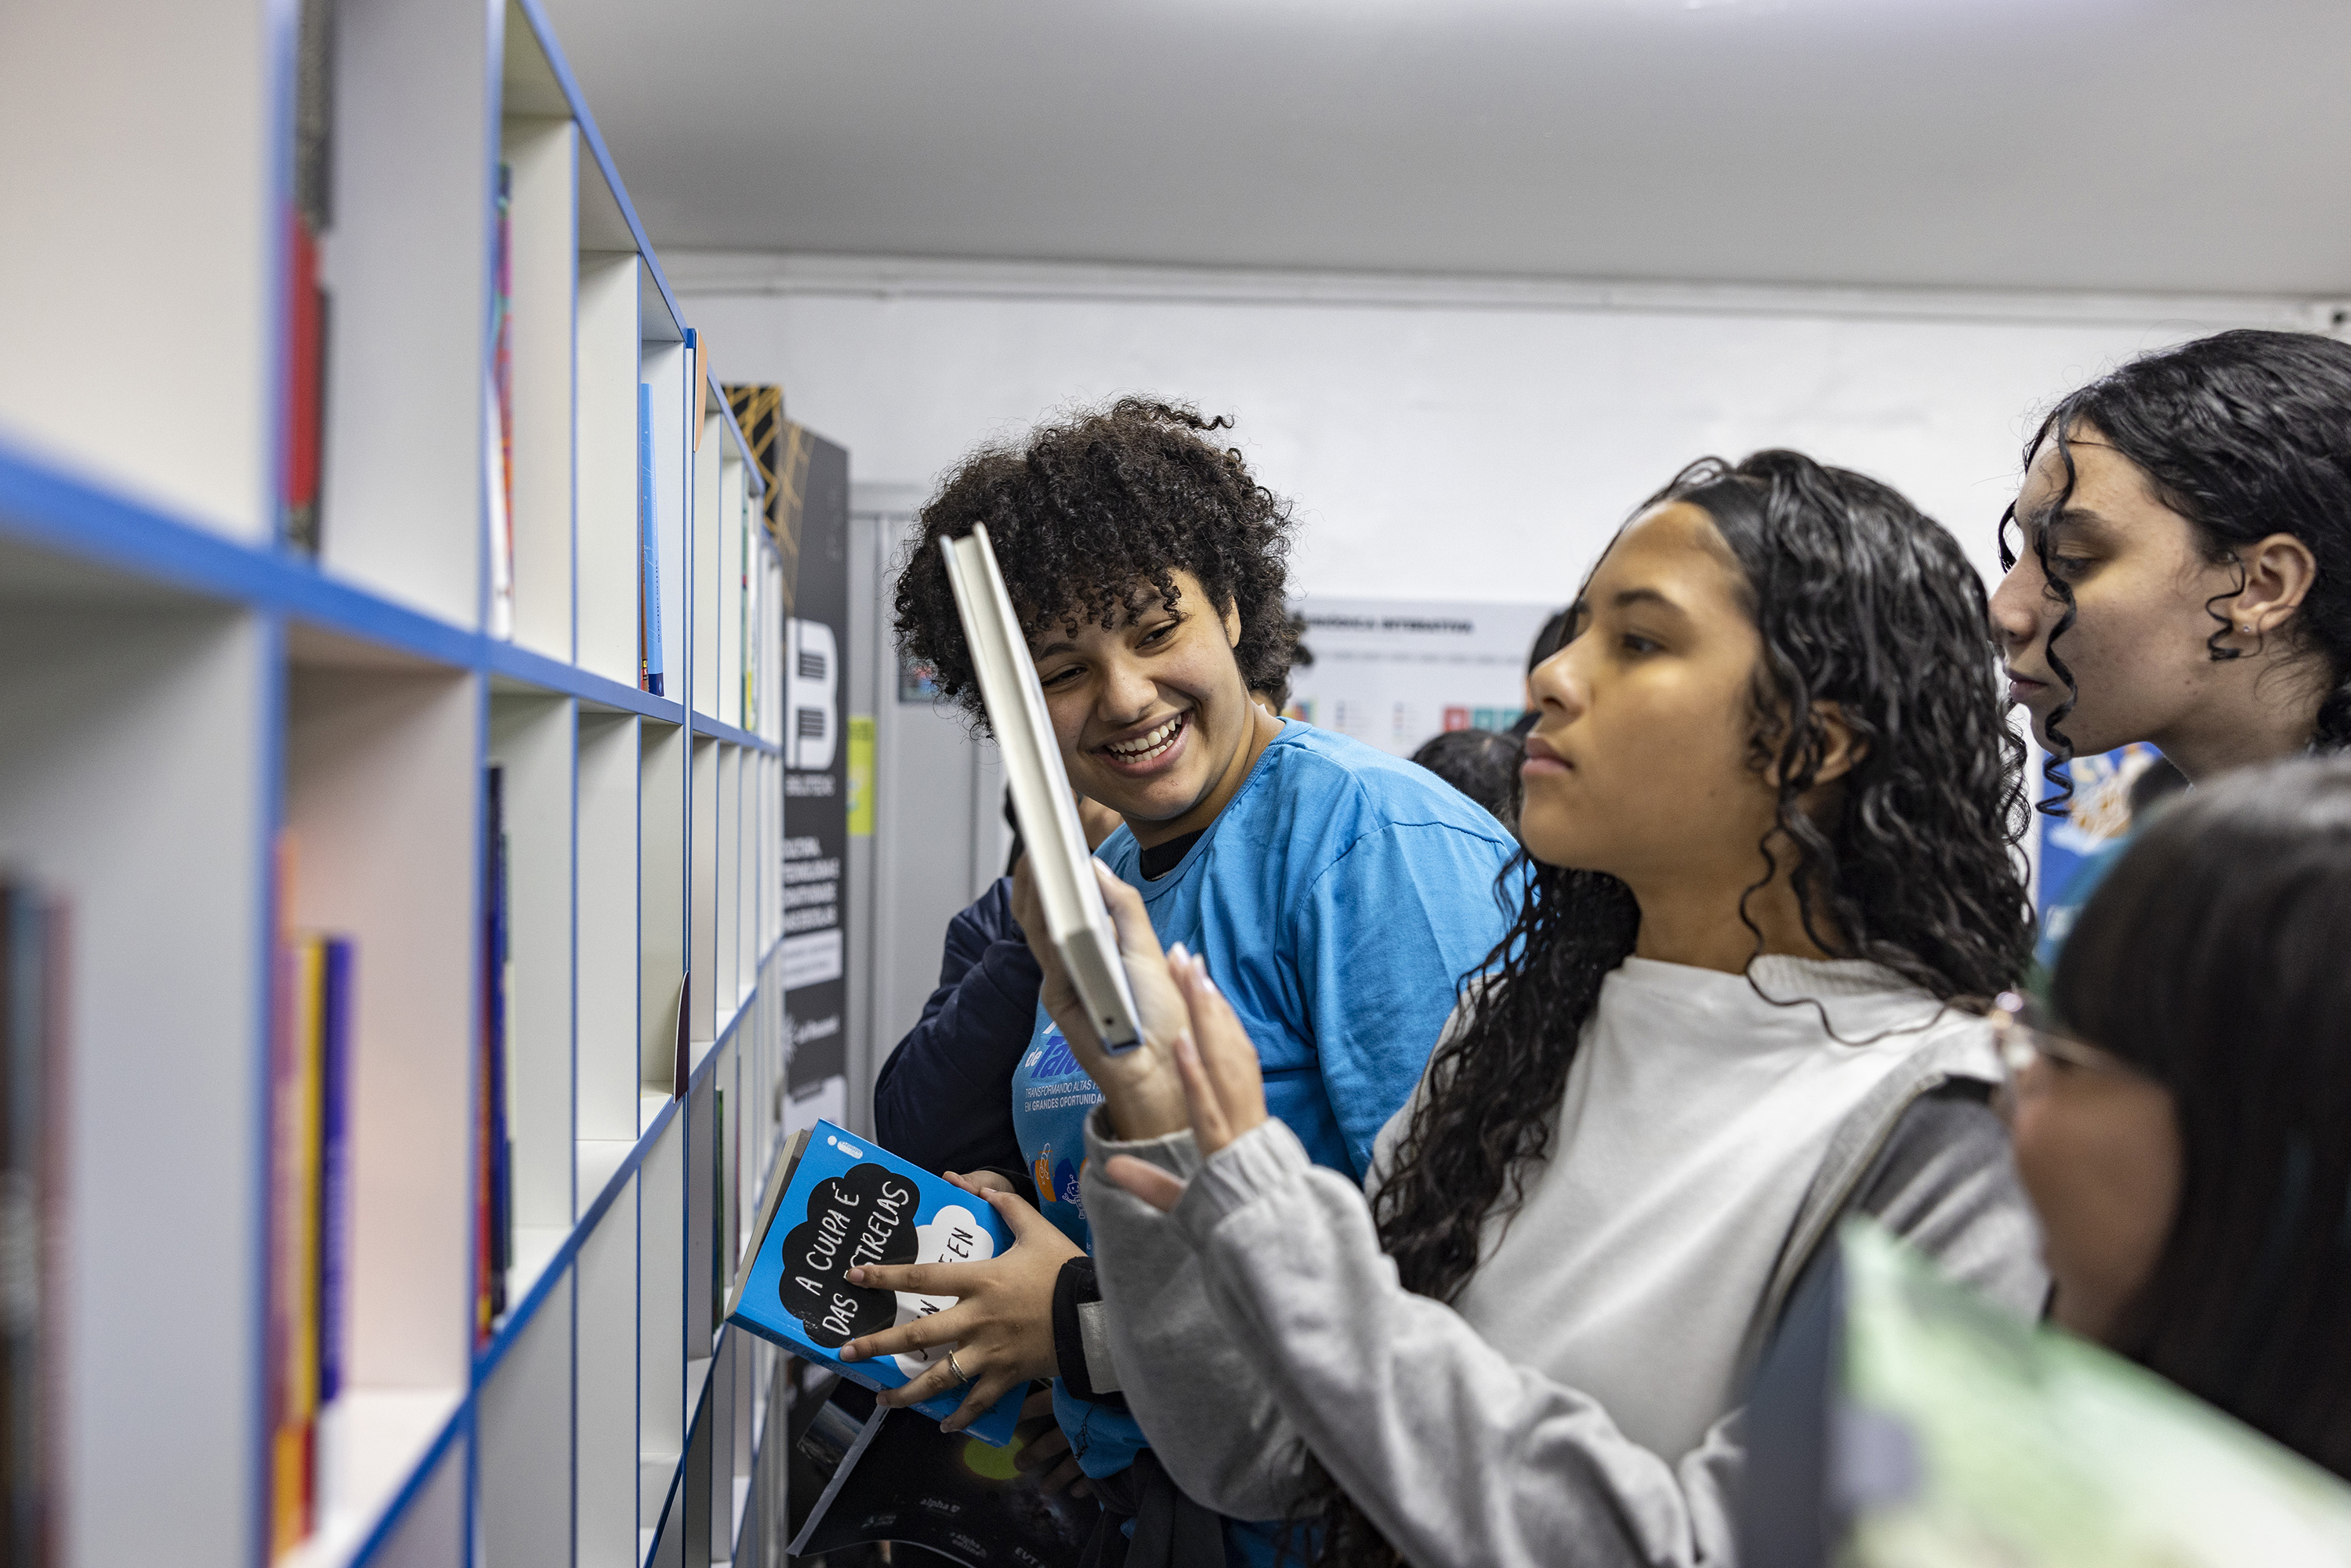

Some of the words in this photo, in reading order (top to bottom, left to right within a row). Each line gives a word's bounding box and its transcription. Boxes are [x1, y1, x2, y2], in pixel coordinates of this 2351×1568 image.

[1024, 1047, 1042, 1067] de
[1025, 1082, 1073, 1099] TRANSFORMANDO
[1072, 1079, 1092, 1093] ALTAS
[1031, 1097, 1059, 1111] GRANDES
[1060, 1093, 1106, 1107] OPORTUNIDA
[831, 1182, 860, 1207] É
[806, 1208, 851, 1271] CULPA
[822, 1293, 858, 1335] DAS
[842, 1181, 909, 1280] STRELAS
[795, 1276, 823, 1296] A
